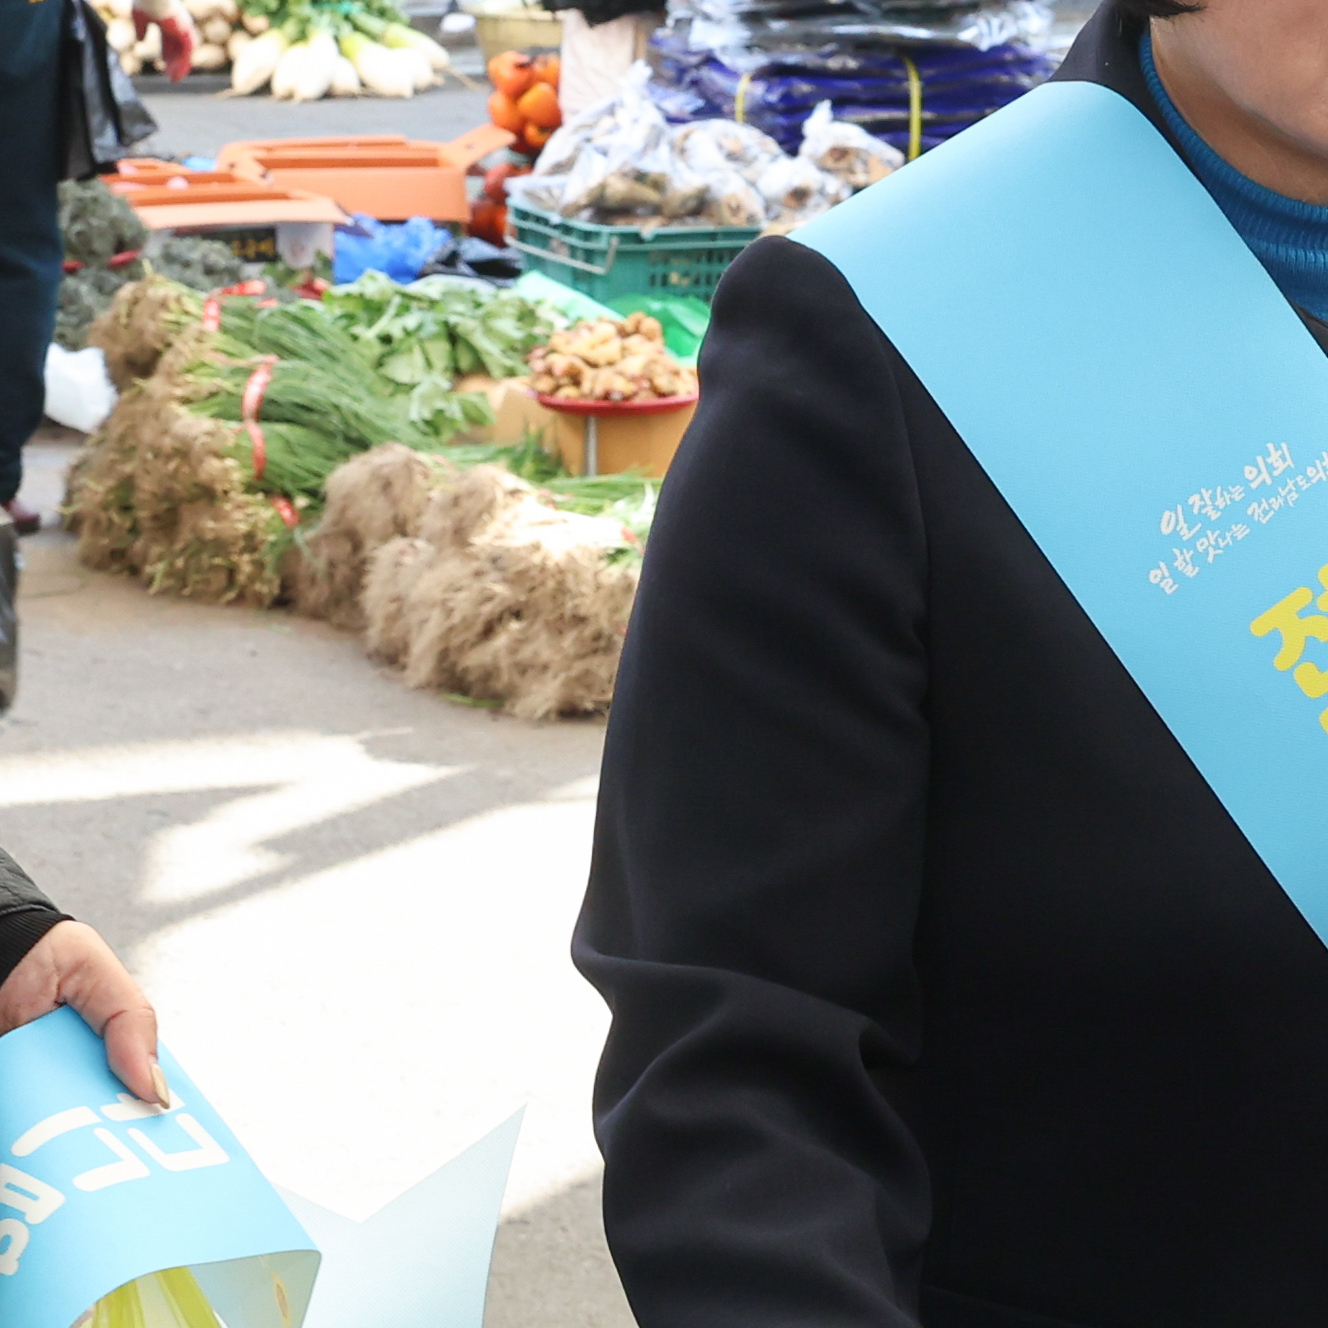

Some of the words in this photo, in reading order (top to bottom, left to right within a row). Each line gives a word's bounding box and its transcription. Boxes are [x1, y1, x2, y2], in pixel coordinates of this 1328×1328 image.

[1160, 503, 1202, 541] 일
[1187, 485, 1245, 521] 잘하는
[1243, 442, 1295, 490] 의회
[1148, 561, 1180, 595] 일
